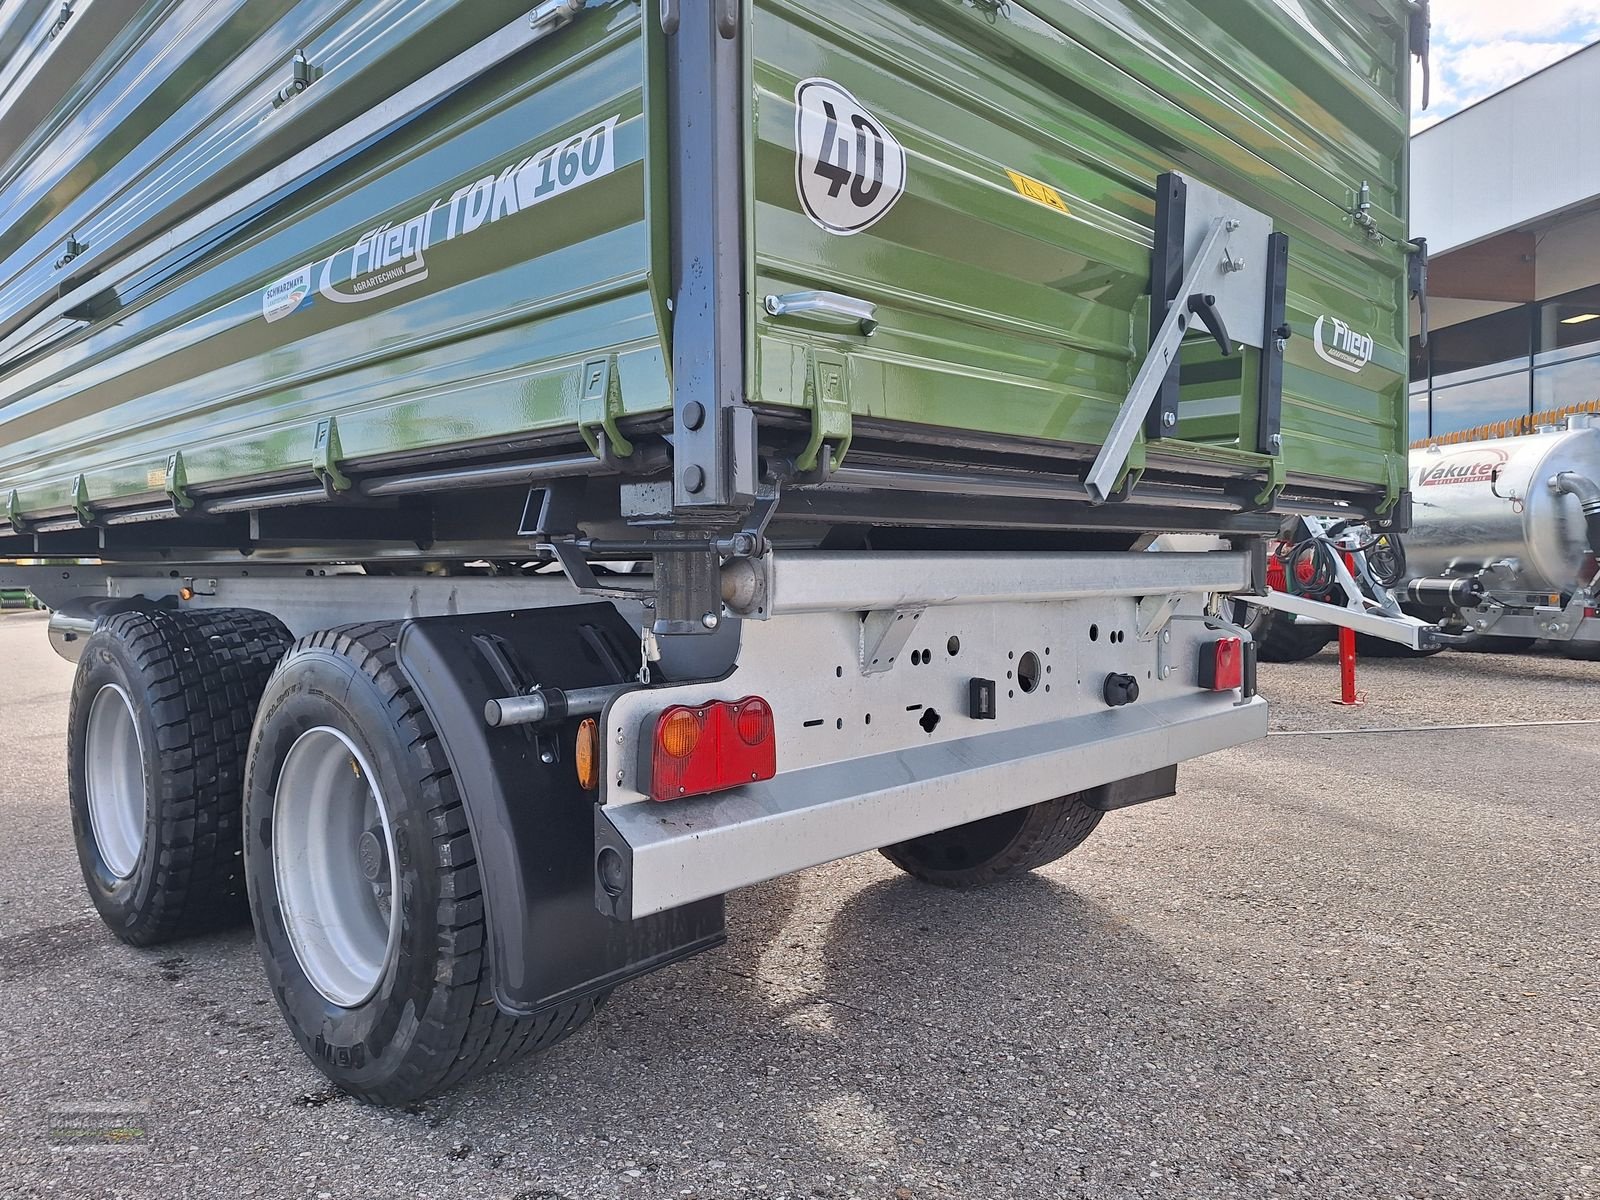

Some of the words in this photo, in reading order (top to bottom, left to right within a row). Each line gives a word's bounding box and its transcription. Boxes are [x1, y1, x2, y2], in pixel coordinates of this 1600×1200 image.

[814, 100, 884, 207] 40
[351, 199, 441, 279] Fliegl
[447, 156, 531, 240] TDK
[534, 125, 606, 198] 160
[266, 275, 304, 300] SCHWARZMAYR
[353, 266, 405, 293] AGRARTECHNIK
[1331, 316, 1373, 367] Fliegl
